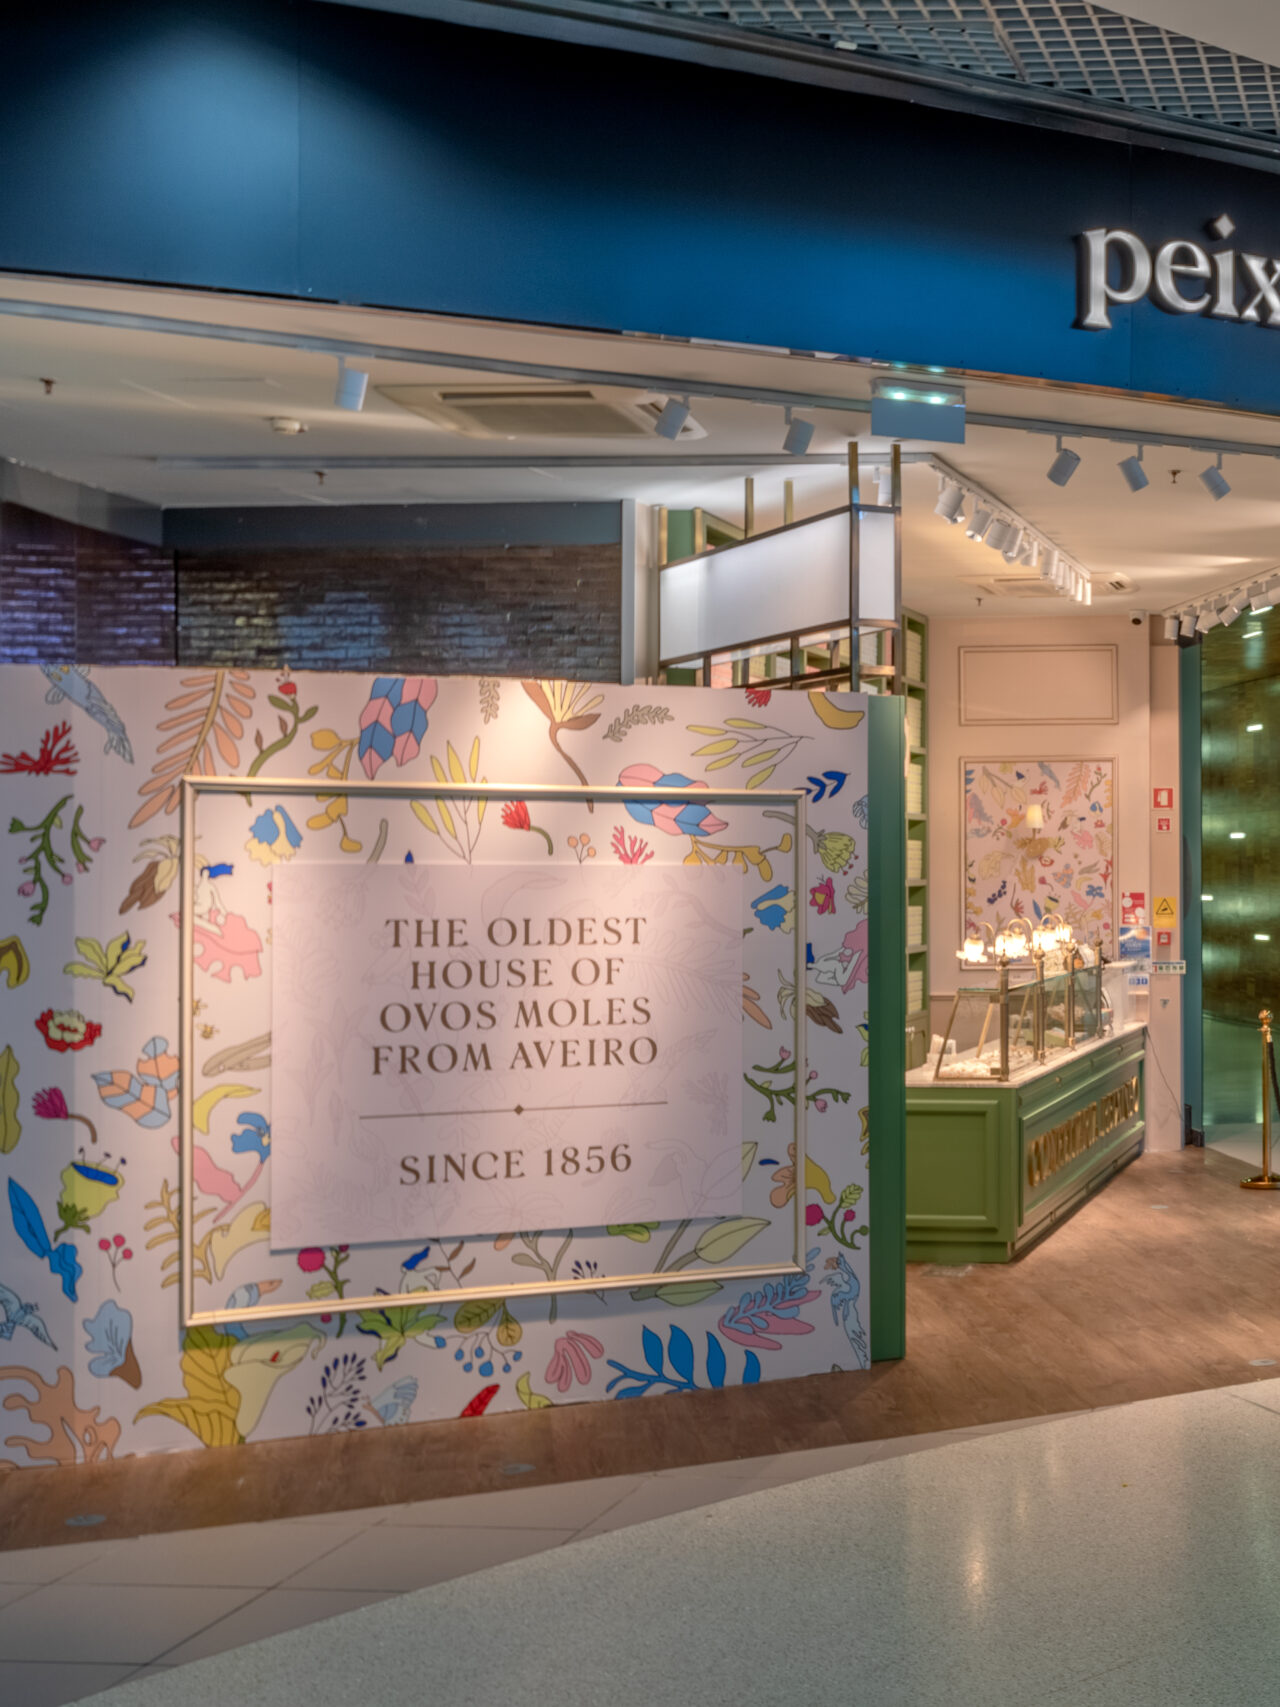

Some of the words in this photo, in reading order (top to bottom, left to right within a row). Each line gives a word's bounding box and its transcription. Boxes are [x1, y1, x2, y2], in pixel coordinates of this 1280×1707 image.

[384, 918, 469, 949] THE
[486, 916, 648, 947] OLDEST
[410, 958, 554, 990] HOUSE
[571, 957, 625, 987] OF
[379, 1000, 497, 1033] OVOS
[514, 997, 652, 1029] MOLES
[372, 1042, 493, 1076] FROM
[509, 1036, 659, 1070] AVEIRO
[399, 1149, 526, 1186] SINCE
[543, 1143, 633, 1177] 1856
